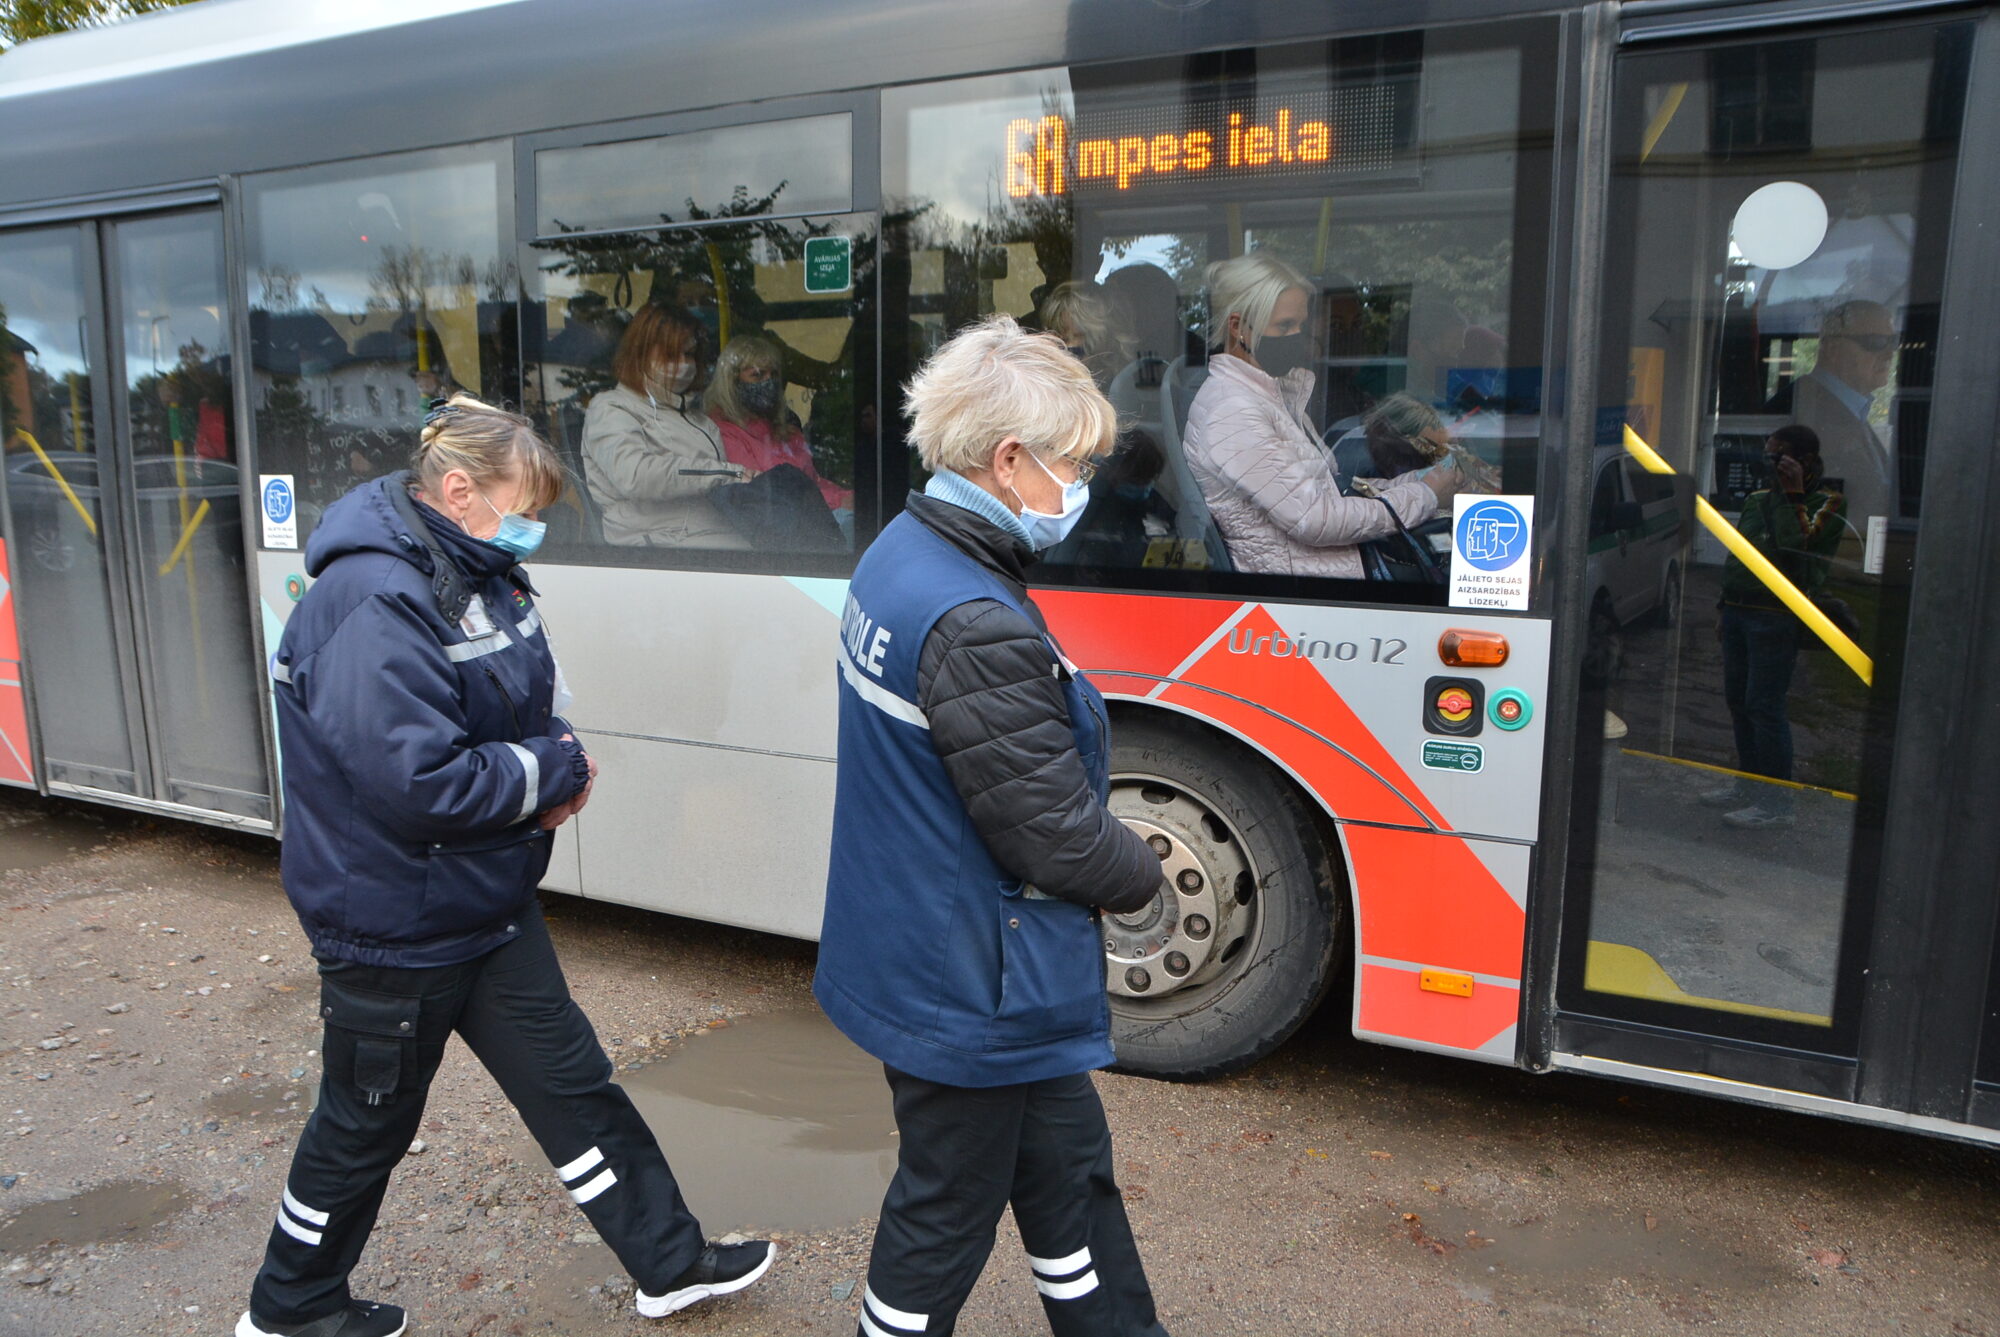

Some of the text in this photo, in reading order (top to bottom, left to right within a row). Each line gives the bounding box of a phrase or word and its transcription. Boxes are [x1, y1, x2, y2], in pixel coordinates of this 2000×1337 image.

[1005, 108, 1329, 197] 6A mpes iela
[1457, 573, 1523, 585] JĀLIETO SEJAS
[1457, 586, 1521, 596] AIZSARDZĪBAS
[1469, 597, 1508, 607] LĪDZEKĻI
[1228, 627, 1408, 666] Urbino 12
